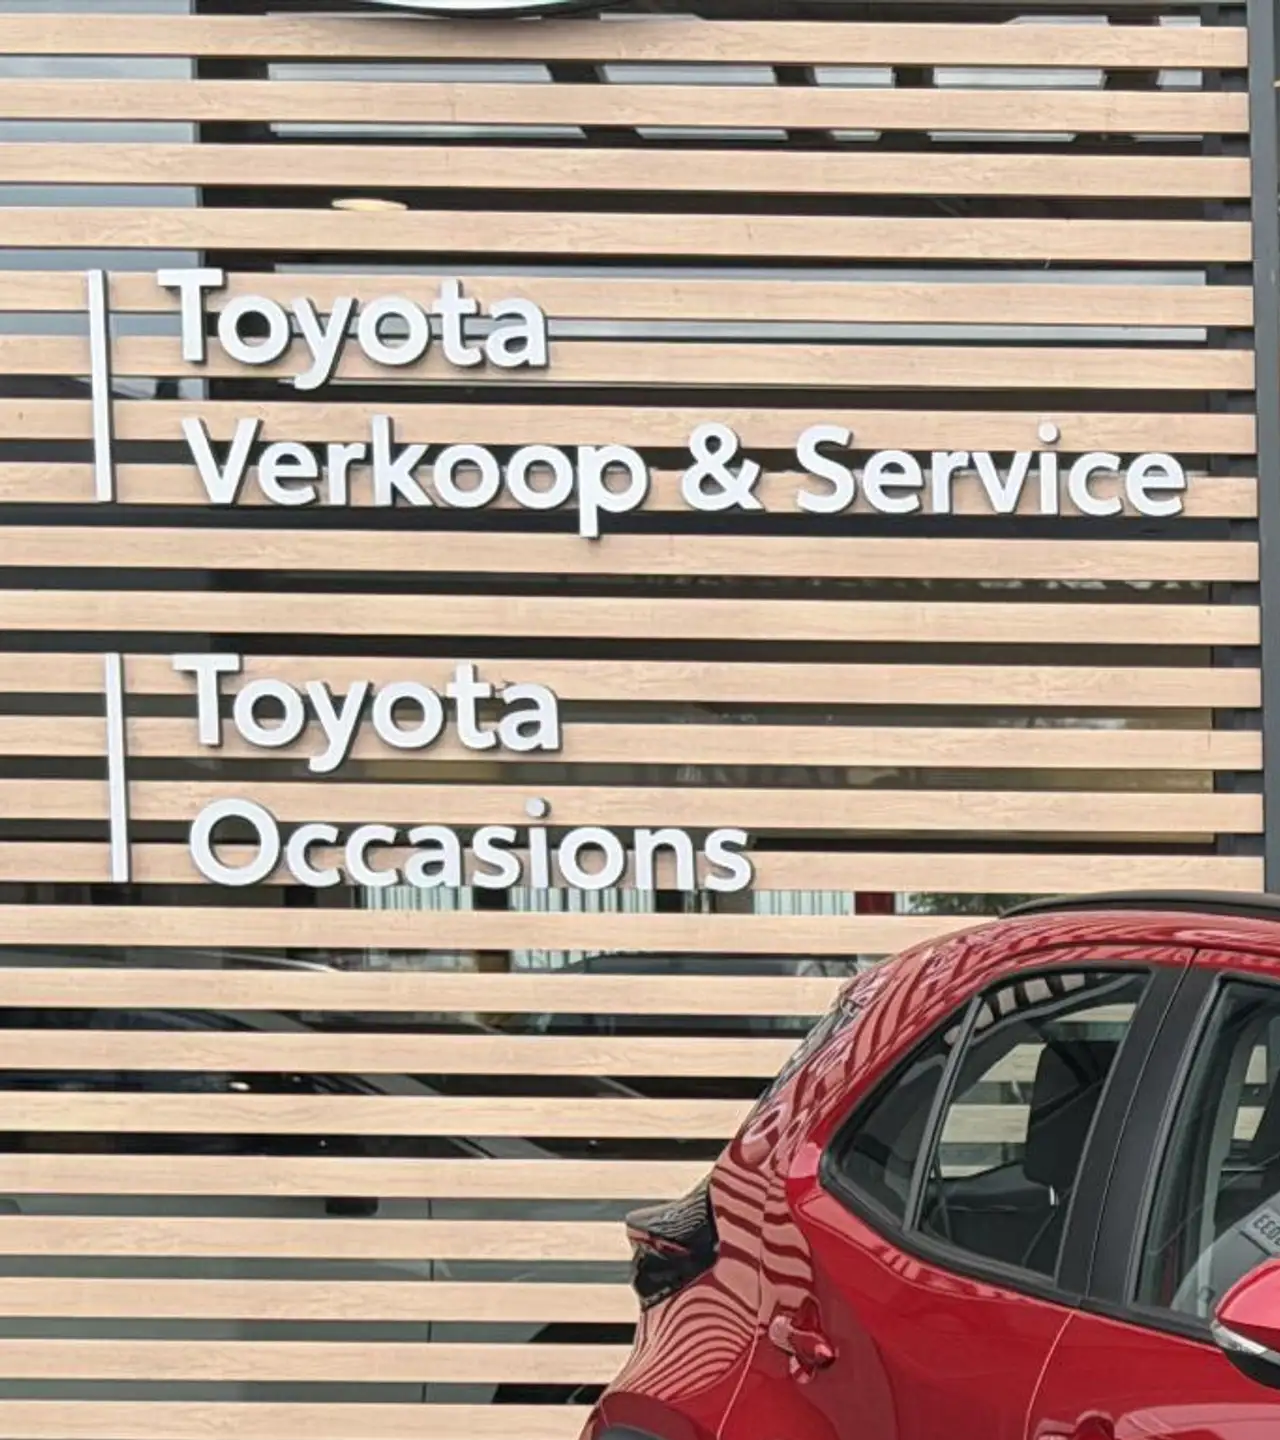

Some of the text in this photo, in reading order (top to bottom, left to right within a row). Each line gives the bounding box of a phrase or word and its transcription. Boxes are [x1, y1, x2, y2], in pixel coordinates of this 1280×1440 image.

[157, 268, 549, 391] Toyota
[183, 413, 1187, 538] Verkoop & Service
[173, 653, 562, 772] Toyota
[190, 797, 754, 893] Occasions
